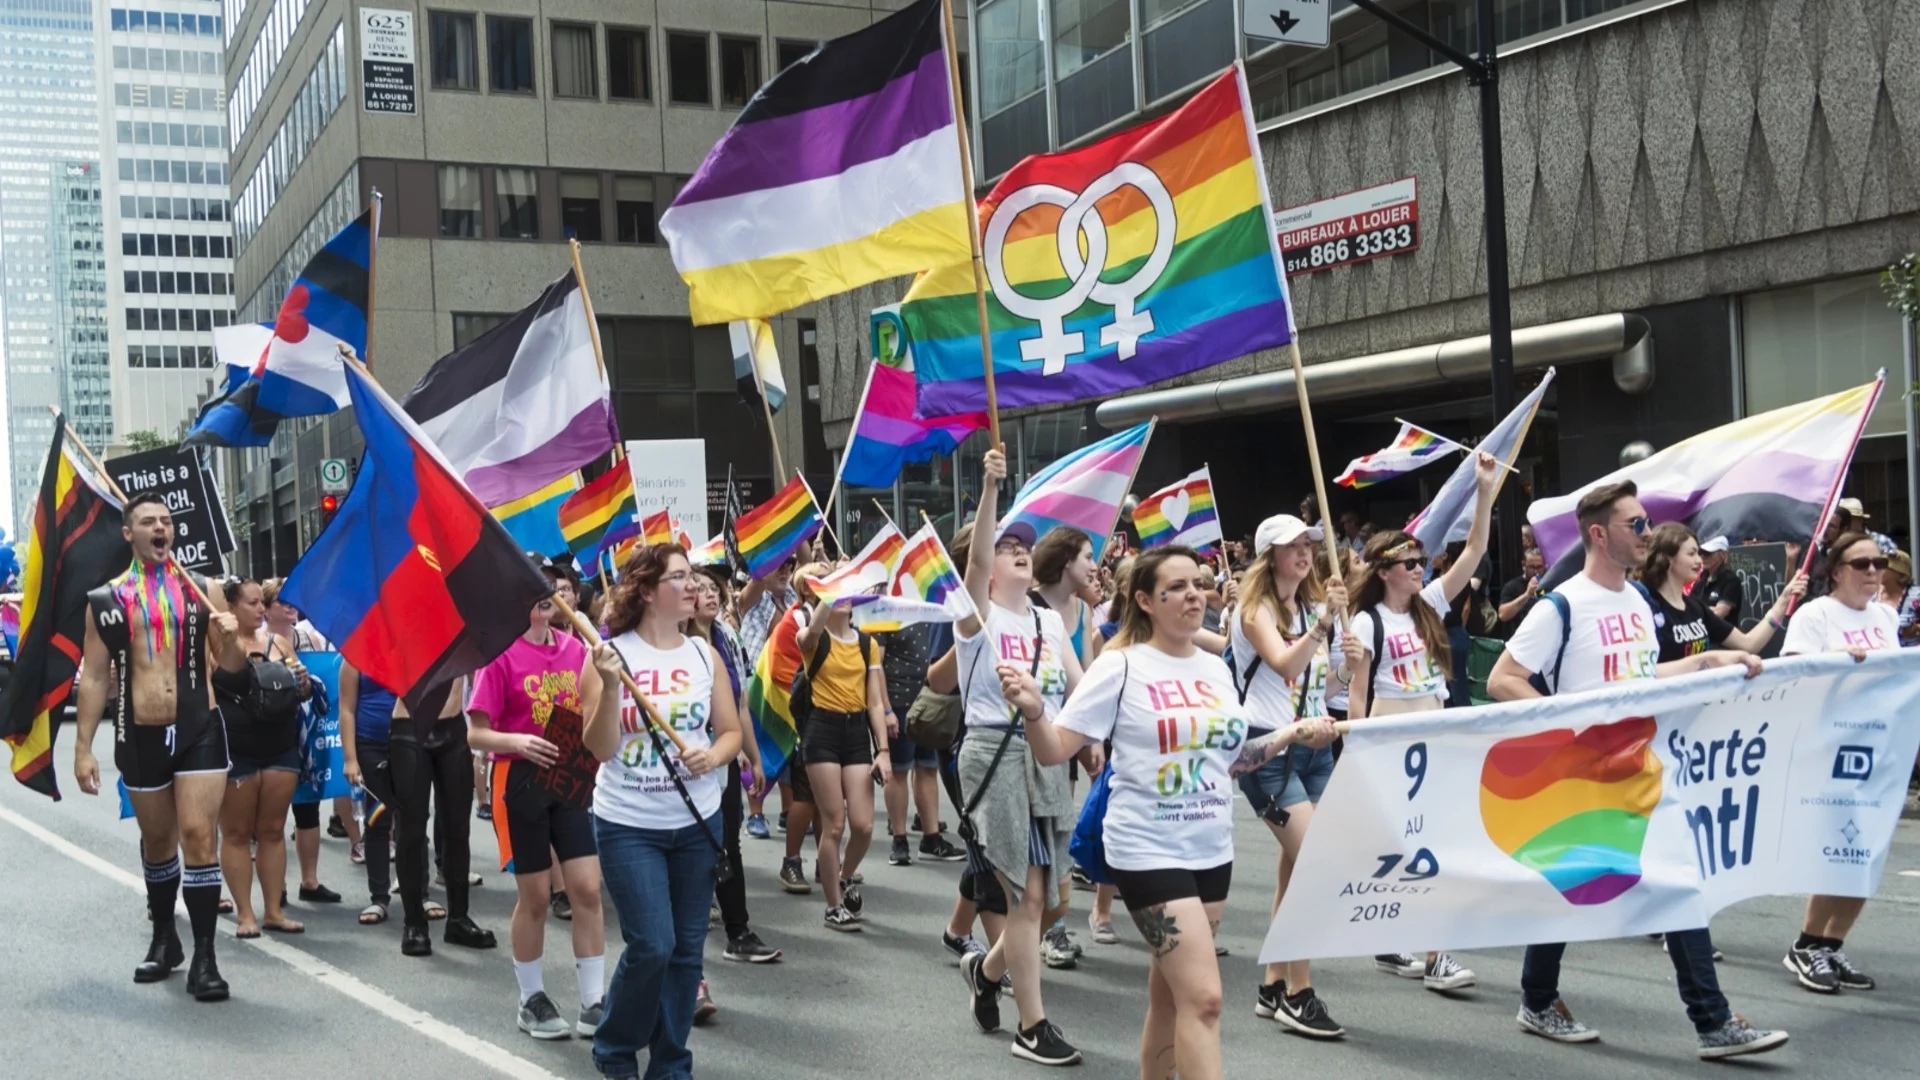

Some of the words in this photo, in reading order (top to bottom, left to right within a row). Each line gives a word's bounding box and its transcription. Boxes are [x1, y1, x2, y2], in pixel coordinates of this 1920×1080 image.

[367, 14, 405, 29] 625
[379, 92, 408, 101] LOUER
[1282, 221, 1345, 248] BUREAUX
[1348, 215, 1359, 233] À
[1362, 205, 1411, 230] LOUER
[1287, 257, 1308, 272] 514
[1310, 239, 1350, 267] 866
[1355, 224, 1412, 257] 3333
[118, 469, 158, 493] This
[160, 465, 176, 484] is
[179, 465, 189, 480] a
[636, 476, 686, 489] Binaries
[661, 494, 678, 506] for
[178, 522, 189, 537] a
[846, 509, 861, 523] 619
[1597, 612, 1648, 646] IELS
[1843, 626, 1892, 651] IELS
[187, 602, 198, 690] Montréal
[1000, 632, 1053, 662] IELS
[1386, 632, 1426, 660] IEL
[1392, 656, 1444, 688] ILLE
[1603, 648, 1657, 682] ILLES
[1146, 680, 1222, 711] IELS
[1157, 716, 1244, 755] ILLES
[1157, 757, 1216, 796] O.K.
[1404, 742, 1428, 801] 9
[1839, 750, 1871, 775] TD
[1404, 814, 1424, 839] AU
[1823, 846, 1871, 858] CASINO
[1339, 881, 1437, 897] AUGUST
[1350, 902, 1402, 923] 2018
